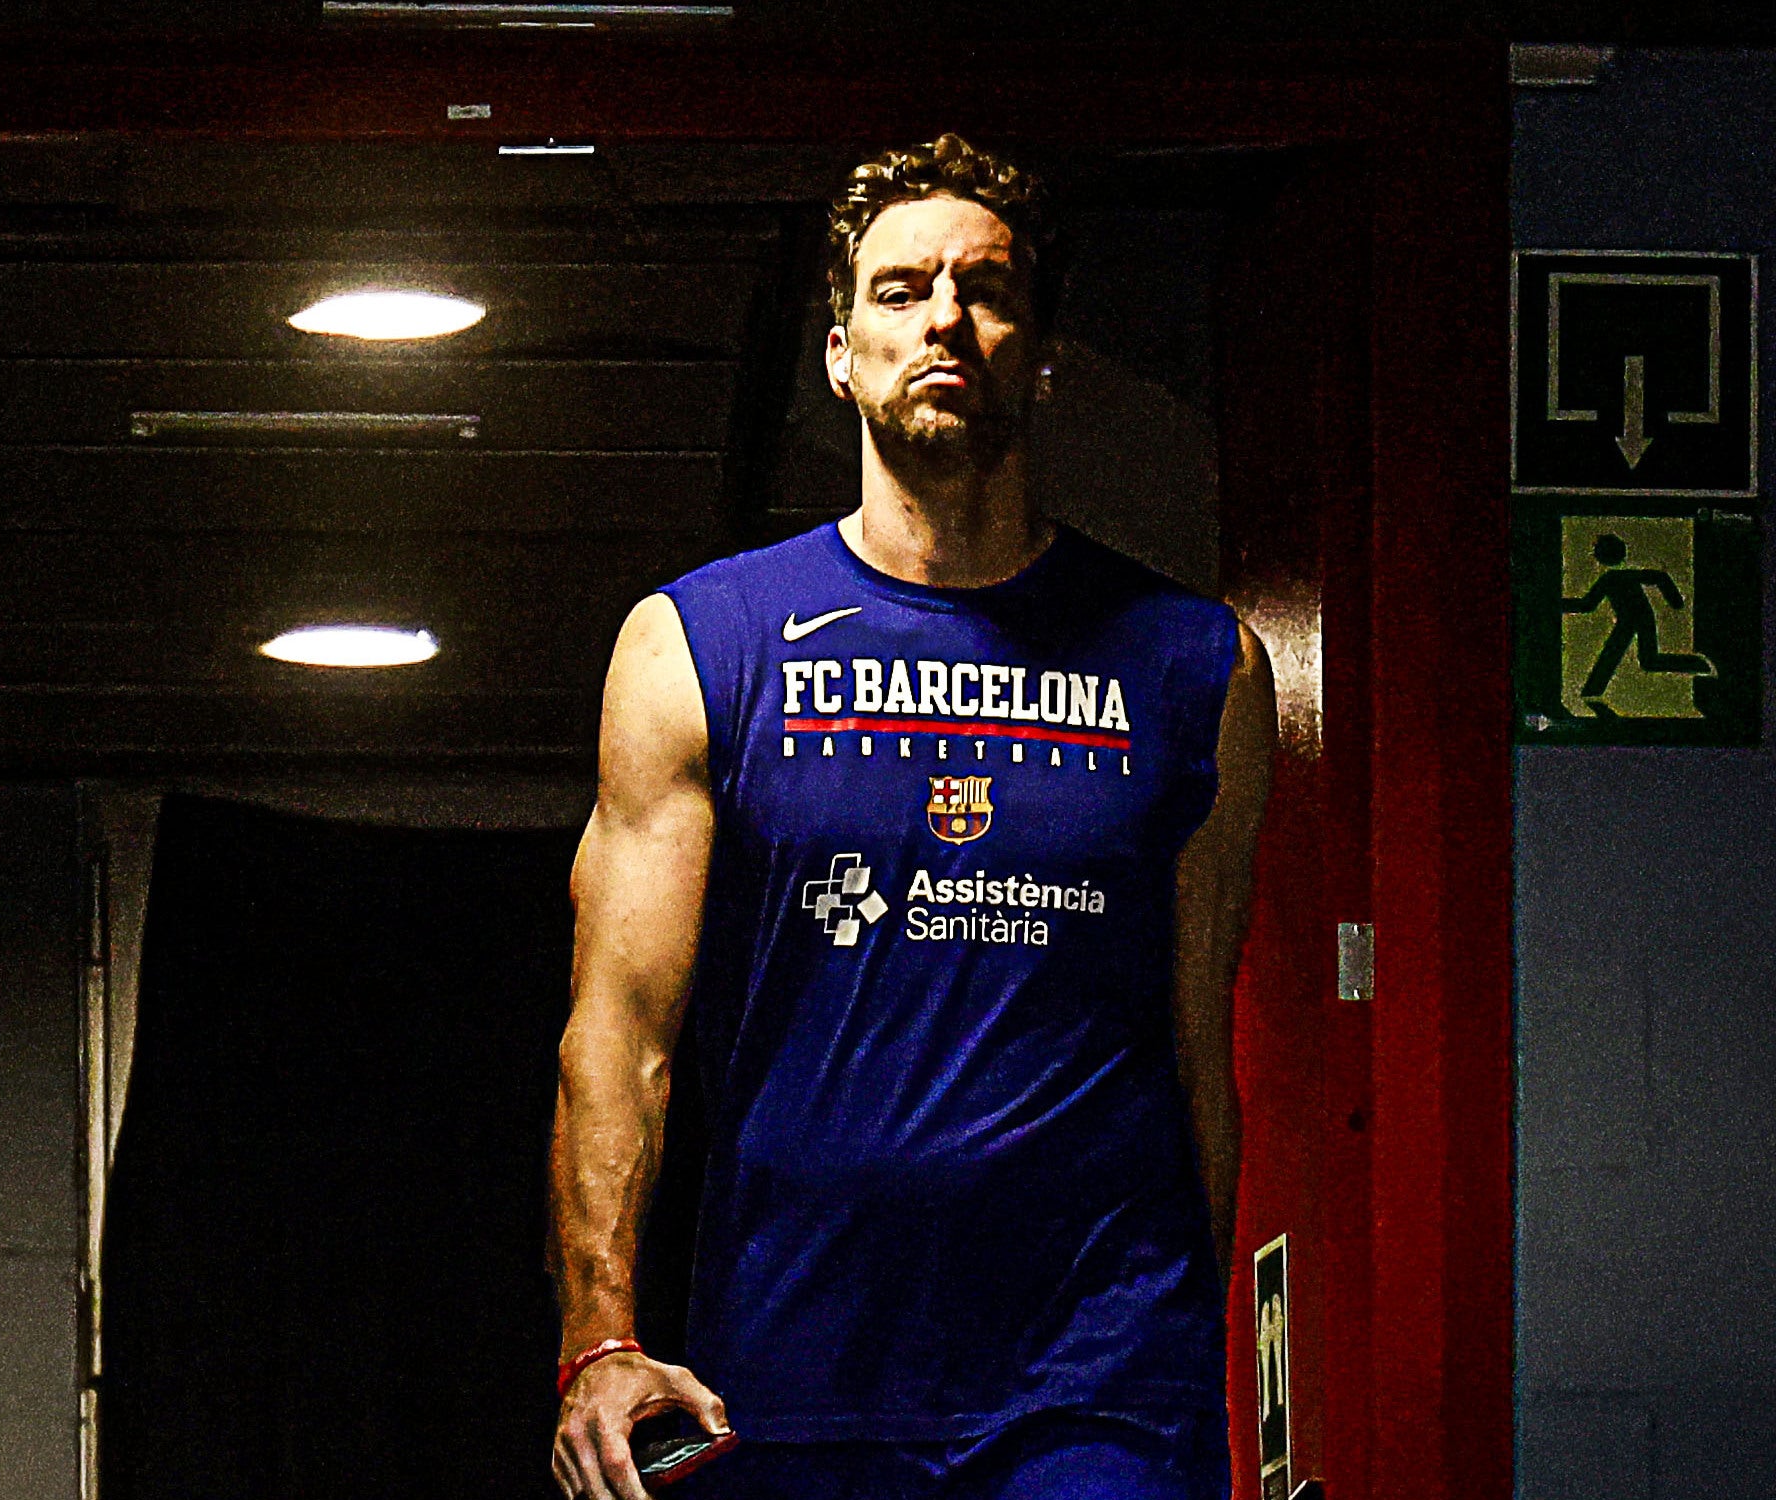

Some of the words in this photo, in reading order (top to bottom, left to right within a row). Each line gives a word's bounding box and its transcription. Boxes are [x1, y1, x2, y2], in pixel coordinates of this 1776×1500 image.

[782, 660, 842, 714] FC
[852, 658, 1130, 732] BARCELONA
[783, 736, 1130, 775] BASKETBALL
[907, 869, 1105, 914] Assistència
[906, 906, 1048, 946] Sanitària
